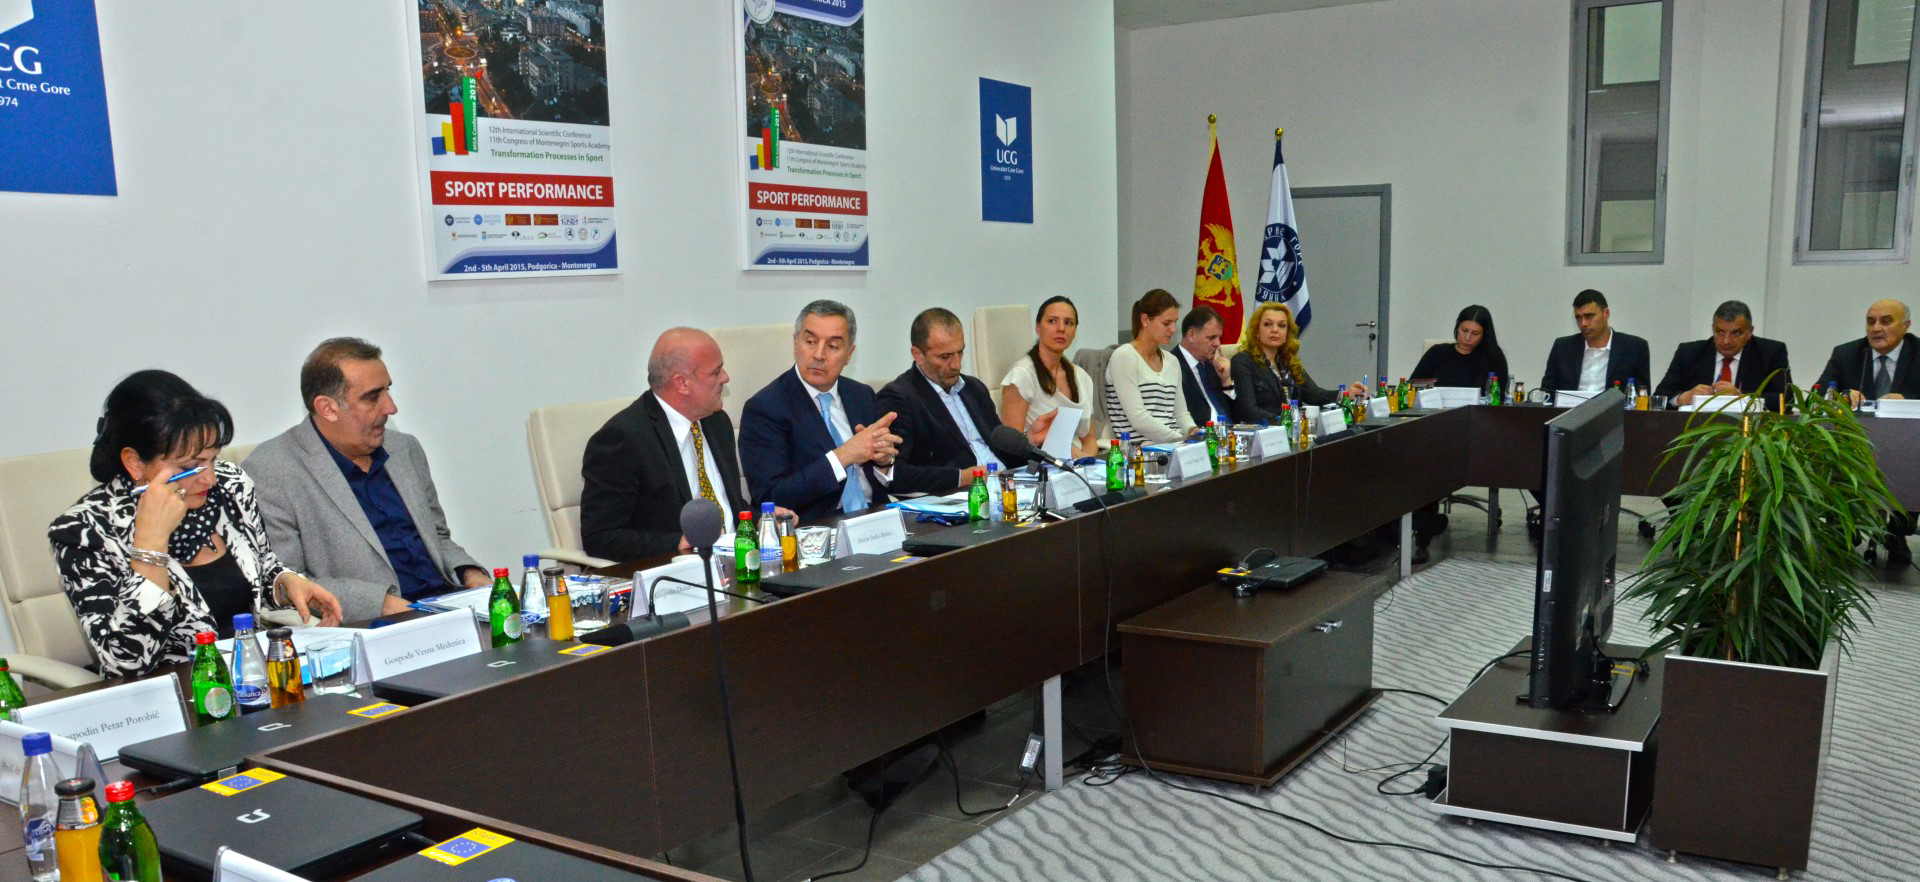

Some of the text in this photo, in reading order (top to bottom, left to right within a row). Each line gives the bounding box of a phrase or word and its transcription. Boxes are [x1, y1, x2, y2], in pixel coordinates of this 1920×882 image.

[6, 78, 37, 92] Crne
[40, 82, 71, 96] Gore
[502, 127, 537, 135] International
[538, 129, 561, 137] Scientific
[563, 131, 591, 139] Conference
[503, 137, 528, 146] Congress
[535, 139, 569, 148] Montenegrin
[571, 141, 587, 149] Sports
[588, 142, 611, 150] Academy
[491, 149, 544, 159] Transformation
[545, 152, 577, 161] Processes
[586, 154, 603, 162] Sport
[996, 148, 1018, 165] UCG
[787, 166, 822, 175] Transformation
[823, 169, 844, 177] Processes
[850, 171, 862, 179] Sport
[445, 181, 603, 199] SPORT PERFORMANCE
[757, 190, 860, 209] SPORT PERFORMANCE
[481, 264, 492, 272] 5th
[494, 264, 508, 272] April
[510, 263, 527, 271] 2015,
[528, 263, 557, 271] Podgorica
[561, 262, 596, 270] Montenegro
[414, 648, 435, 657] Vesna
[435, 639, 466, 652] Medenica
[58, 710, 160, 741] ospodin Petar Porobić
